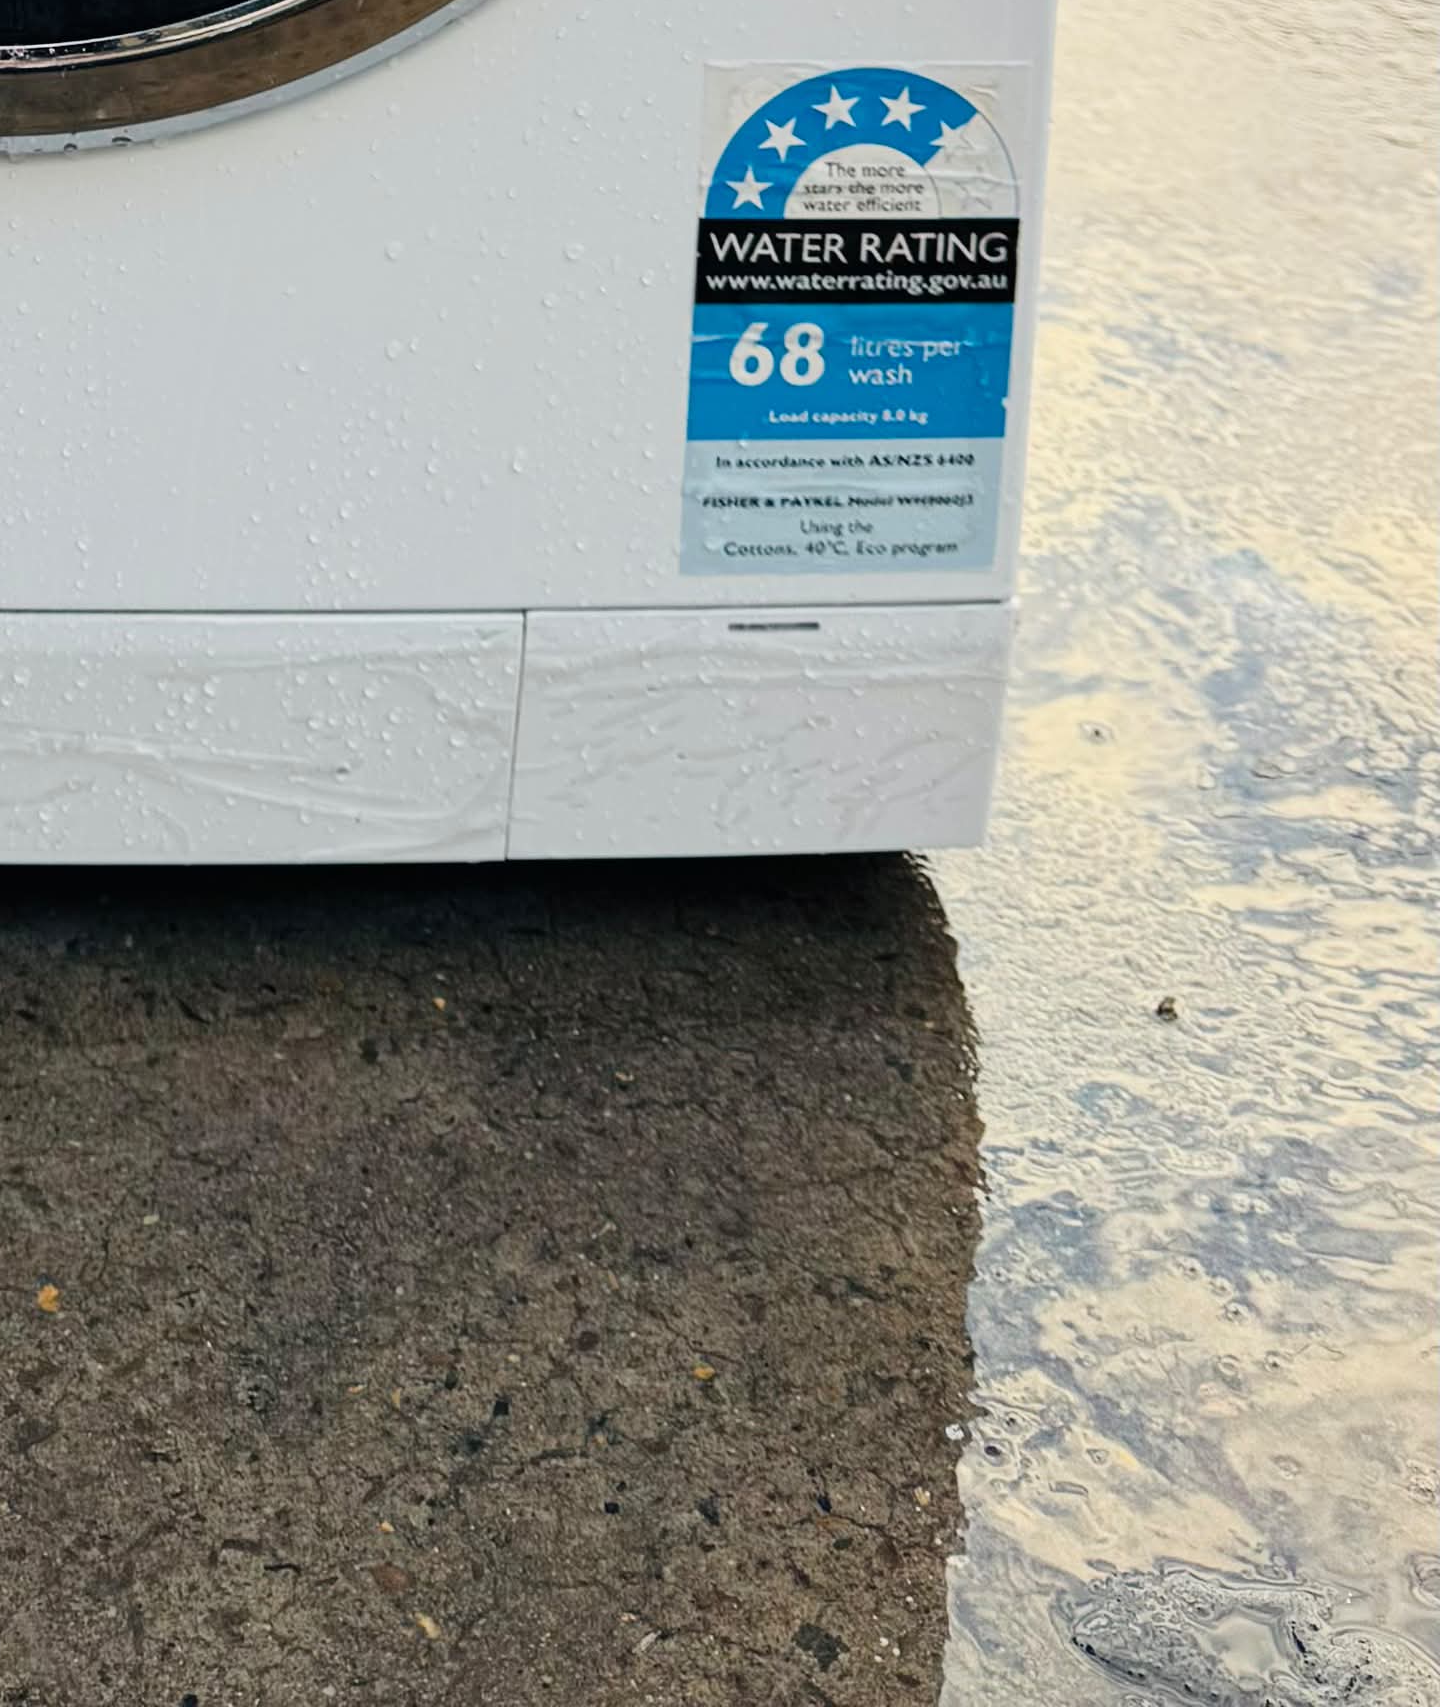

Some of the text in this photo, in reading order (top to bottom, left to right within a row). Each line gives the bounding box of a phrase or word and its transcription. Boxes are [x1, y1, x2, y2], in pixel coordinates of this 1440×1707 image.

[825, 161, 905, 177] The more
[803, 182, 924, 195] stars the more
[803, 196, 921, 212] water efficient
[710, 231, 1008, 264] WATER RATING
[706, 271, 1008, 295] www.waterrating.gov.au
[728, 322, 825, 387] 68
[851, 336, 961, 362] litres per
[848, 364, 913, 385] wash
